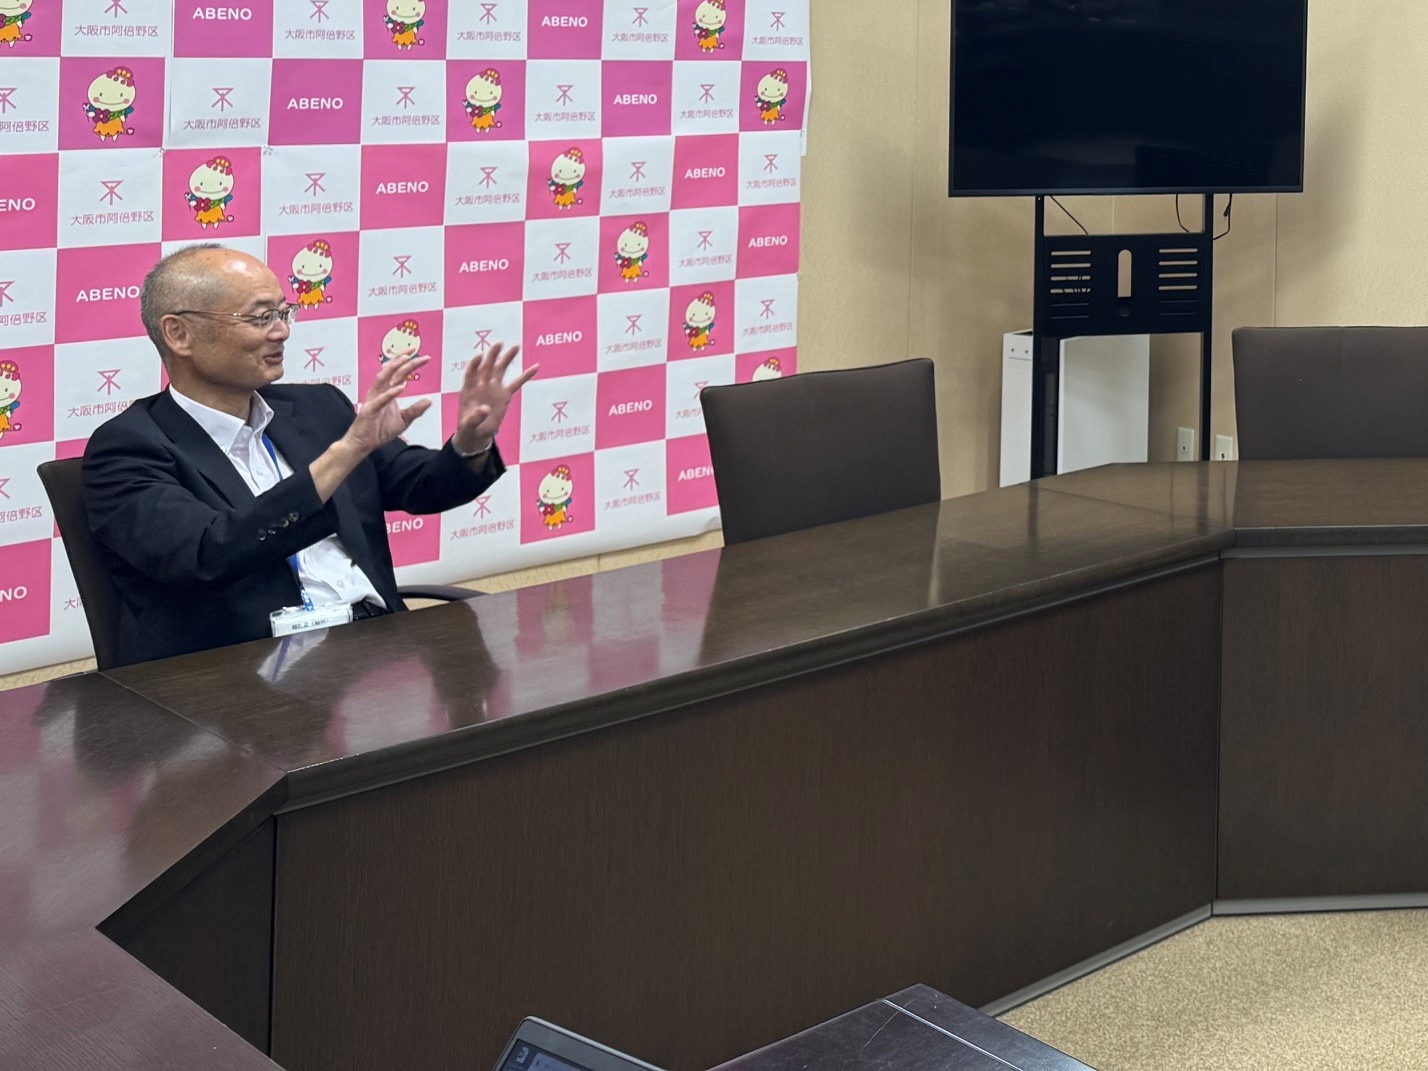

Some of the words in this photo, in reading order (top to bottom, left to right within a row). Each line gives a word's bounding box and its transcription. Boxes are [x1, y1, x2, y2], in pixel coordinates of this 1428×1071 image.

[193, 8, 251, 20] ABENO
[542, 16, 587, 27] ABENO
[75, 25, 158, 37] 大阪市阿倍野区
[285, 29, 354, 40] 大阪市阿倍野区
[457, 31, 521, 41] 大阪市阿倍野区
[288, 98, 343, 109] ABENO
[614, 94, 657, 104] ABENO
[184, 118, 260, 130] 大阪市阿倍野区
[372, 115, 439, 126] 大阪市阿倍野区
[685, 167, 725, 178] ABENO
[376, 182, 428, 194] ABENO
[456, 194, 519, 205] 大阪市阿倍野区
[279, 202, 353, 215] 大阪市阿倍野区
[71, 211, 153, 226] 大阪市阿倍野区
[749, 235, 787, 247] ABENO
[460, 259, 508, 272] ABENO
[76, 286, 140, 302] ABENO
[369, 282, 436, 296] 大阪市阿倍野区
[537, 331, 582, 345] ABENO
[609, 400, 652, 415] ABENO
[679, 467, 713, 480] ABEN
[451, 520, 514, 539] 大阪市阿倍野区
